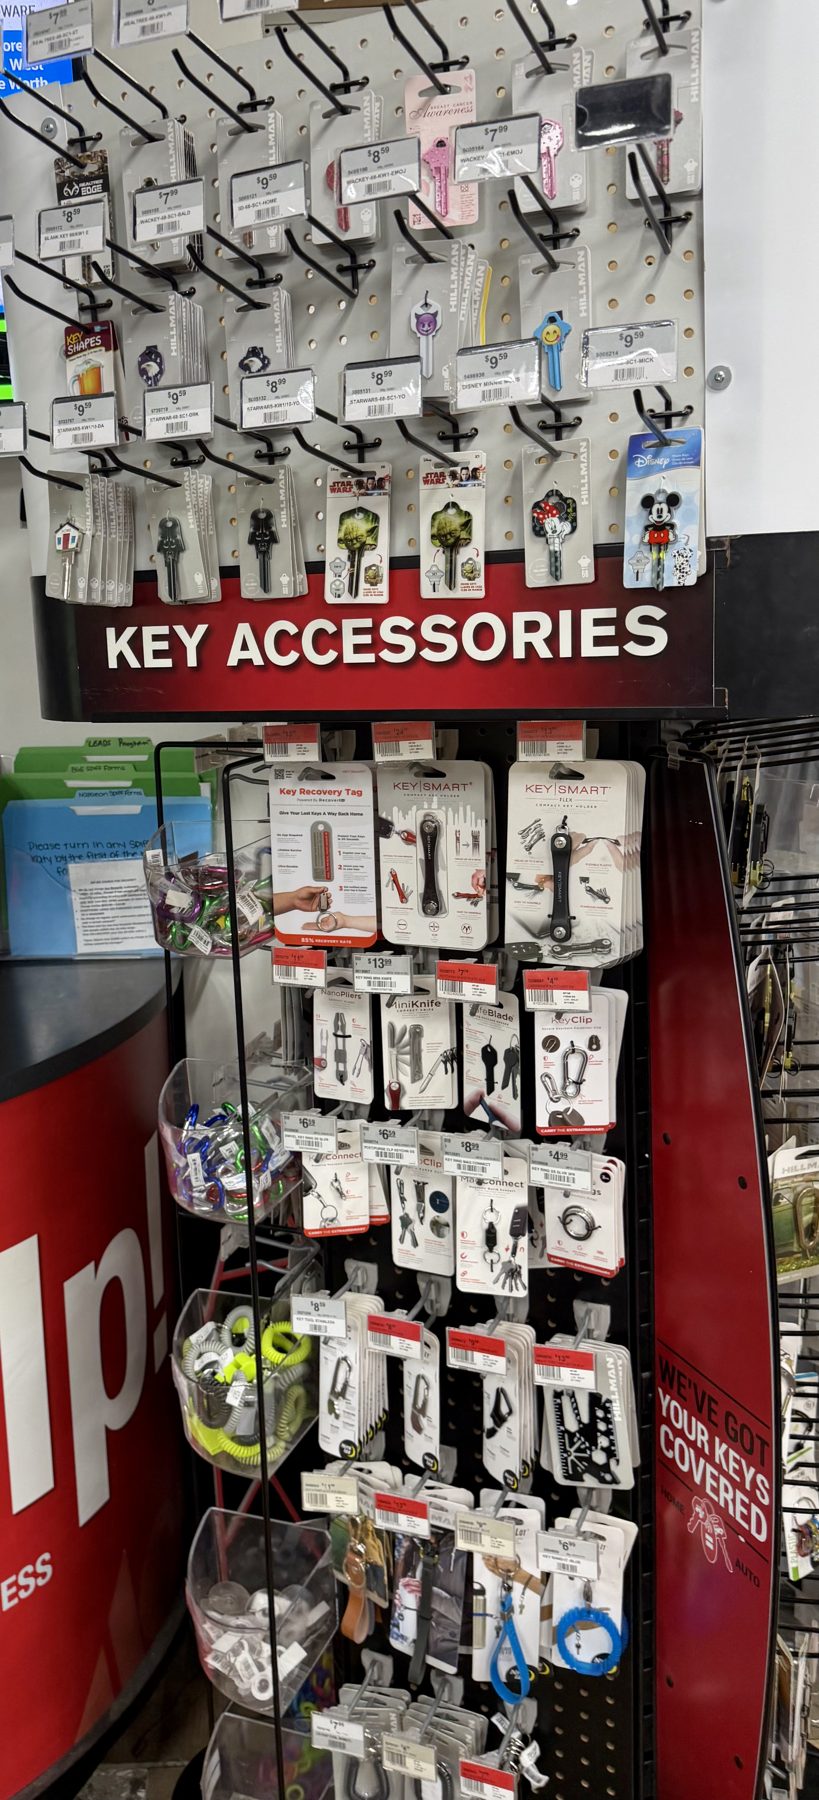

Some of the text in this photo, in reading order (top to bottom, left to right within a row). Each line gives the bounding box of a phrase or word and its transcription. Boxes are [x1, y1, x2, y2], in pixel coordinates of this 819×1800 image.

[690, 29, 700, 104] HILLMAN
[409, 103, 474, 120] Awareness
[81, 184, 103, 196] EDGE
[449, 243, 460, 313] HILLMAN
[579, 249, 588, 318] HILLMAN
[169, 294, 178, 356] HILLMAN
[271, 291, 283, 354] HILLMAN
[66, 331, 84, 346] KEY
[67, 335, 102, 355] SHAPES
[461, 382, 483, 391] DISNEY
[329, 480, 354, 488] STAR
[422, 471, 447, 480] STAR
[422, 477, 447, 486] WARS
[579, 441, 588, 505] HILLMAN
[183, 471, 195, 529] HILLMAN
[278, 468, 287, 528] HILLMAN
[329, 486, 353, 494] WARS
[106, 604, 669, 669] KEY ACCESSORIES
[279, 787, 363, 797] Key Recovery Tag
[28, 841, 61, 851] Please
[92, 841, 105, 849] in
[106, 841, 126, 850] any
[86, 851, 107, 860] first
[109, 850, 120, 859] of
[122, 850, 138, 858] the
[321, 988, 362, 1000] NanoPliers
[782, 1161, 819, 1175] HILLM
[604, 1356, 622, 1422] HILLMAN
[659, 1358, 770, 1467] WE'VE GOT
[657, 1387, 770, 1507] YOUR KEYS
[659, 1424, 768, 1544] COVERED
[660, 1485, 685, 1514] HOME
[735, 1557, 761, 1589] AUTO
